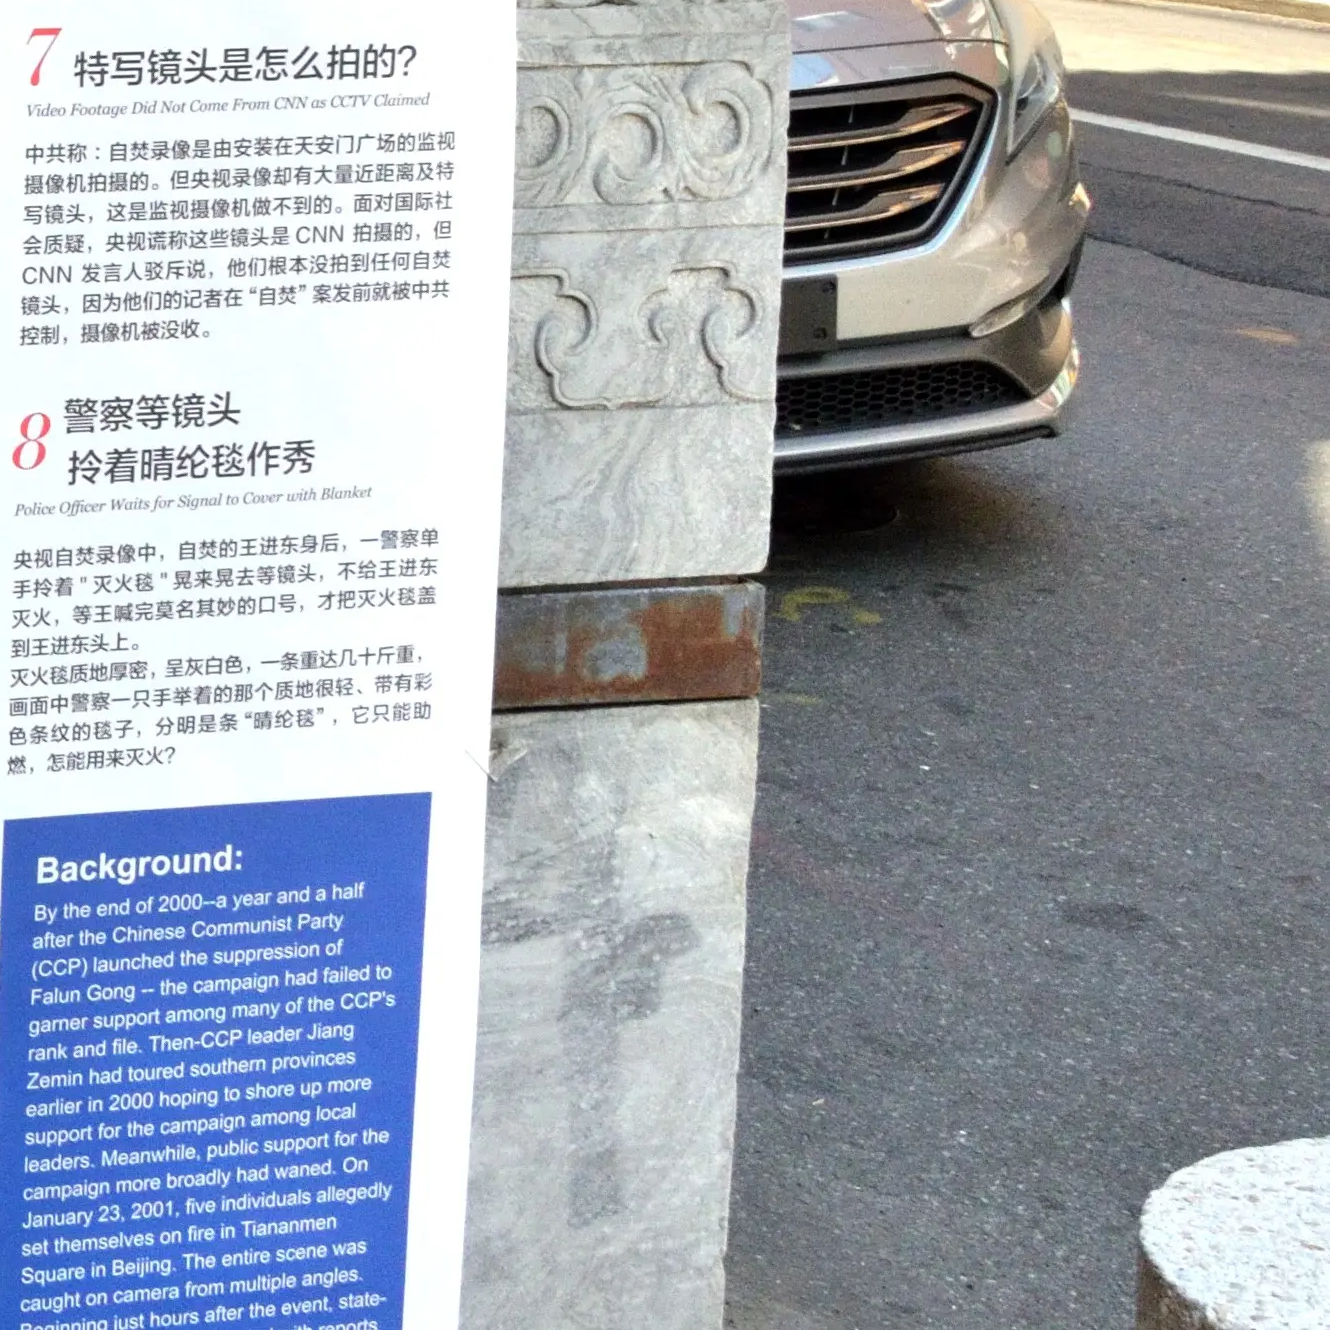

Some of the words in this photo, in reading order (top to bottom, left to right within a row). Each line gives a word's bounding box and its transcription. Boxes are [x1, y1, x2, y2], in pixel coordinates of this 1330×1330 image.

[26, 27, 62, 86] 7
[27, 102, 66, 117] Video
[70, 102, 128, 118] Footage
[131, 99, 158, 114] Did
[160, 100, 186, 113] Not
[189, 99, 229, 112] Come
[232, 97, 270, 111] From
[273, 96, 308, 110] CNN
[310, 99, 326, 108] as
[330, 94, 372, 108] CCTV
[373, 91, 430, 107] Claimed
[63, 391, 241, 434] 警察等镜头
[12, 412, 51, 470] 8
[68, 439, 315, 486] 拎着晴纶毯作秀
[36, 844, 242, 884] Background:
[22, 1210, 93, 1229] January
[97, 1204, 124, 1222] 23,
[130, 1200, 179, 1219] 2001,
[184, 1197, 216, 1214] five
[221, 1189, 312, 1211] individuals
[316, 1181, 392, 1205] allegedly
